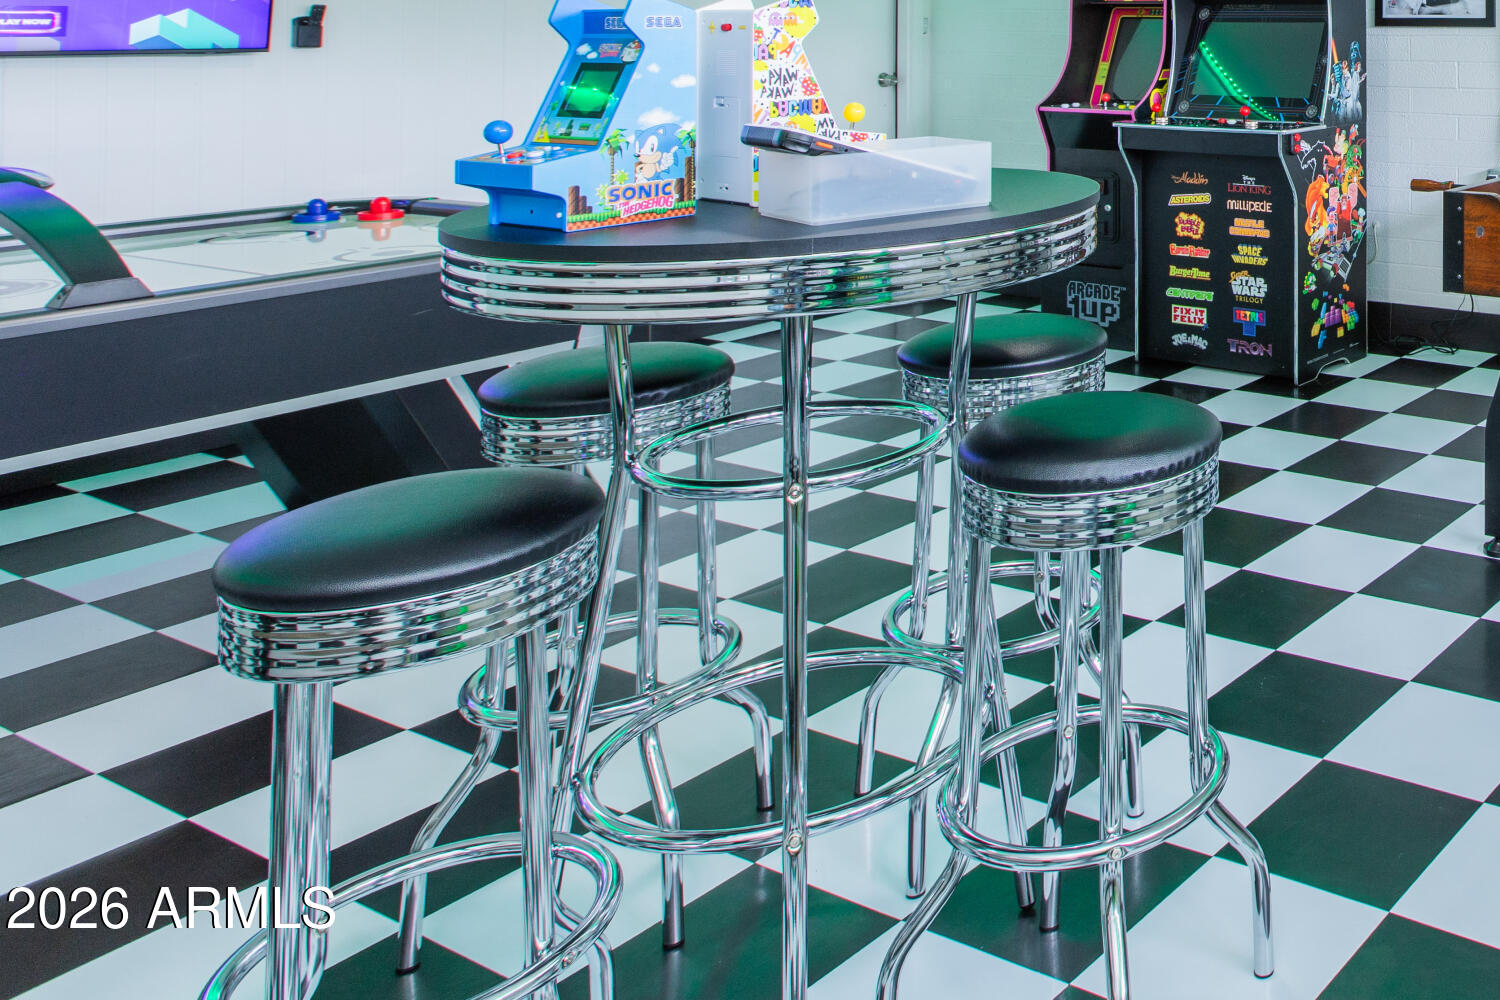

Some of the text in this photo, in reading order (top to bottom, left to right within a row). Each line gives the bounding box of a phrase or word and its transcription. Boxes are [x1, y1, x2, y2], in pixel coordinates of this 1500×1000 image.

[645, 16, 682, 29] SEGA
[608, 182, 673, 203] SONIC
[1170, 194, 1210, 204] ASTEROIDS
[622, 196, 674, 217] HEDGEHOG
[1237, 244, 1262, 257] SPACE
[1232, 276, 1267, 287] STAR
[1067, 281, 1120, 302] ARCADE
[1232, 284, 1268, 297] WARS
[1235, 295, 1264, 304] TRILOGY
[1173, 306, 1206, 316] FIX-IT
[1235, 309, 1264, 323] TETRIS
[1173, 314, 1204, 325] FELIX
[1227, 338, 1272, 358] TRON
